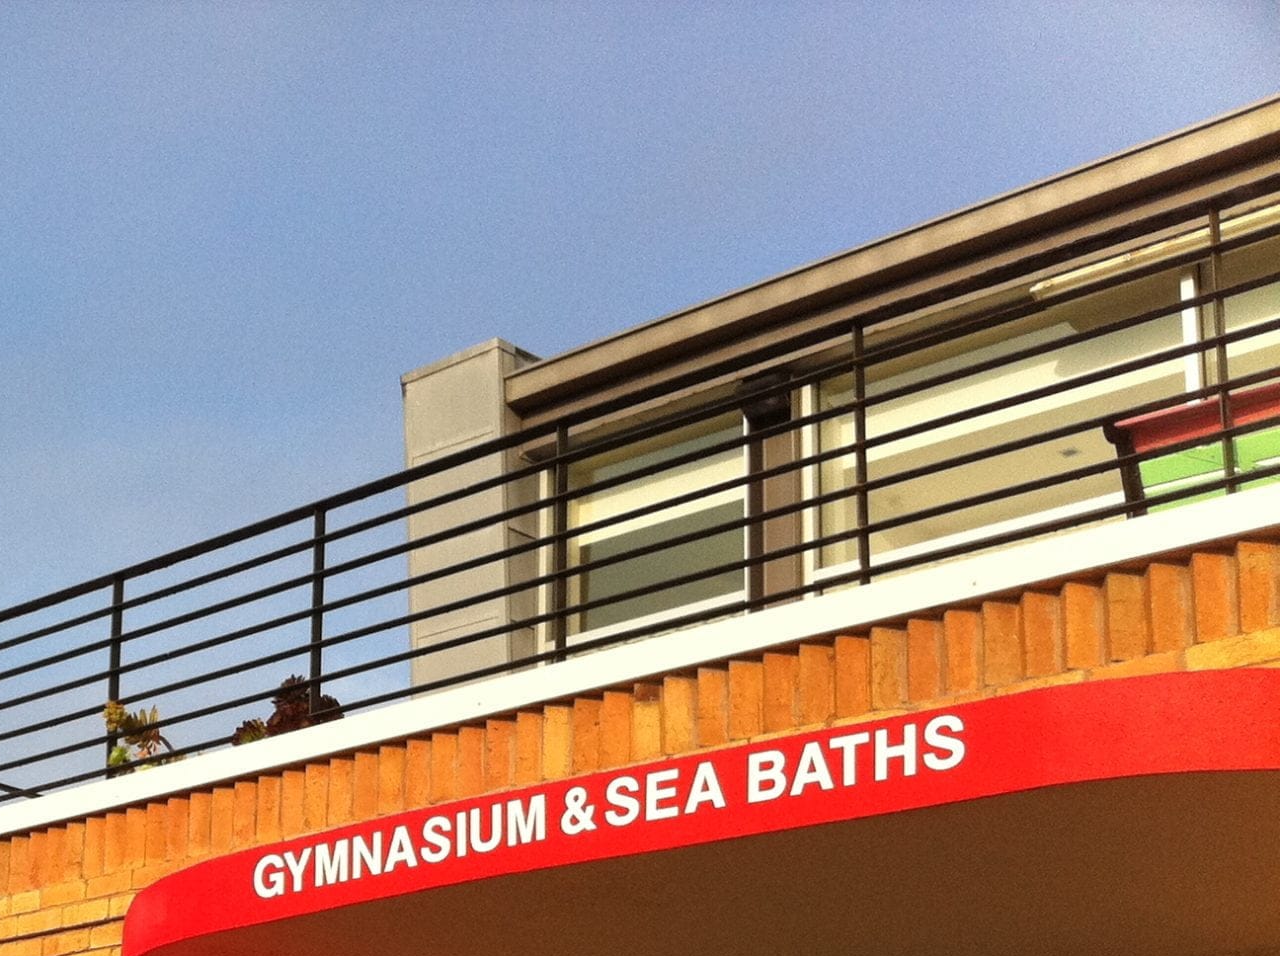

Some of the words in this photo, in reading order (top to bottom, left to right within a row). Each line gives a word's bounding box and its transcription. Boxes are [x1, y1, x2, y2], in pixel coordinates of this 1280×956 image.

[252, 794, 547, 899] GYMNASIUM
[560, 786, 597, 835] &
[604, 761, 725, 826] SEA
[747, 714, 967, 803] BATHS
